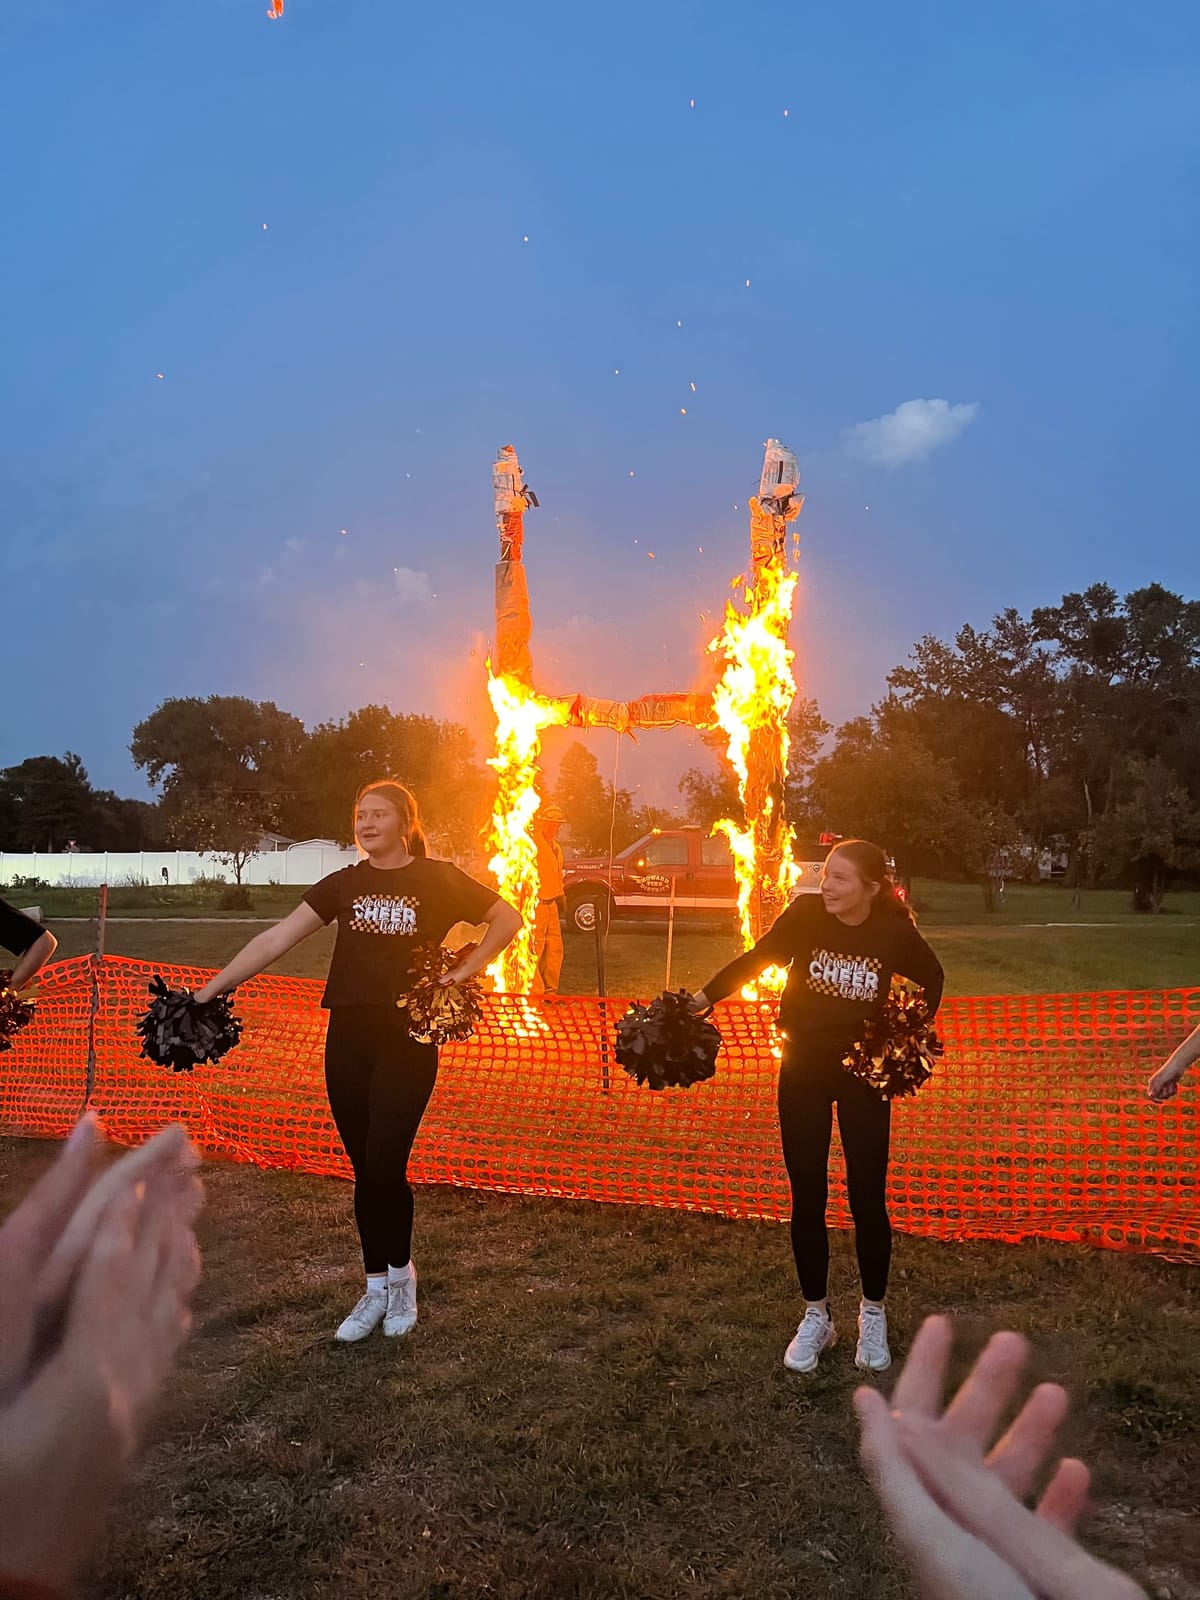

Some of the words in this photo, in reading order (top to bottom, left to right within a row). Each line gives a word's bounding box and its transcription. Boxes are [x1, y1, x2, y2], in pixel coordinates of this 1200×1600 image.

[640, 875, 670, 884] HOWARD
[639, 883, 670, 893] DISTRICT
[352, 904, 417, 925] CHEER
[809, 960, 879, 991] CHEER
